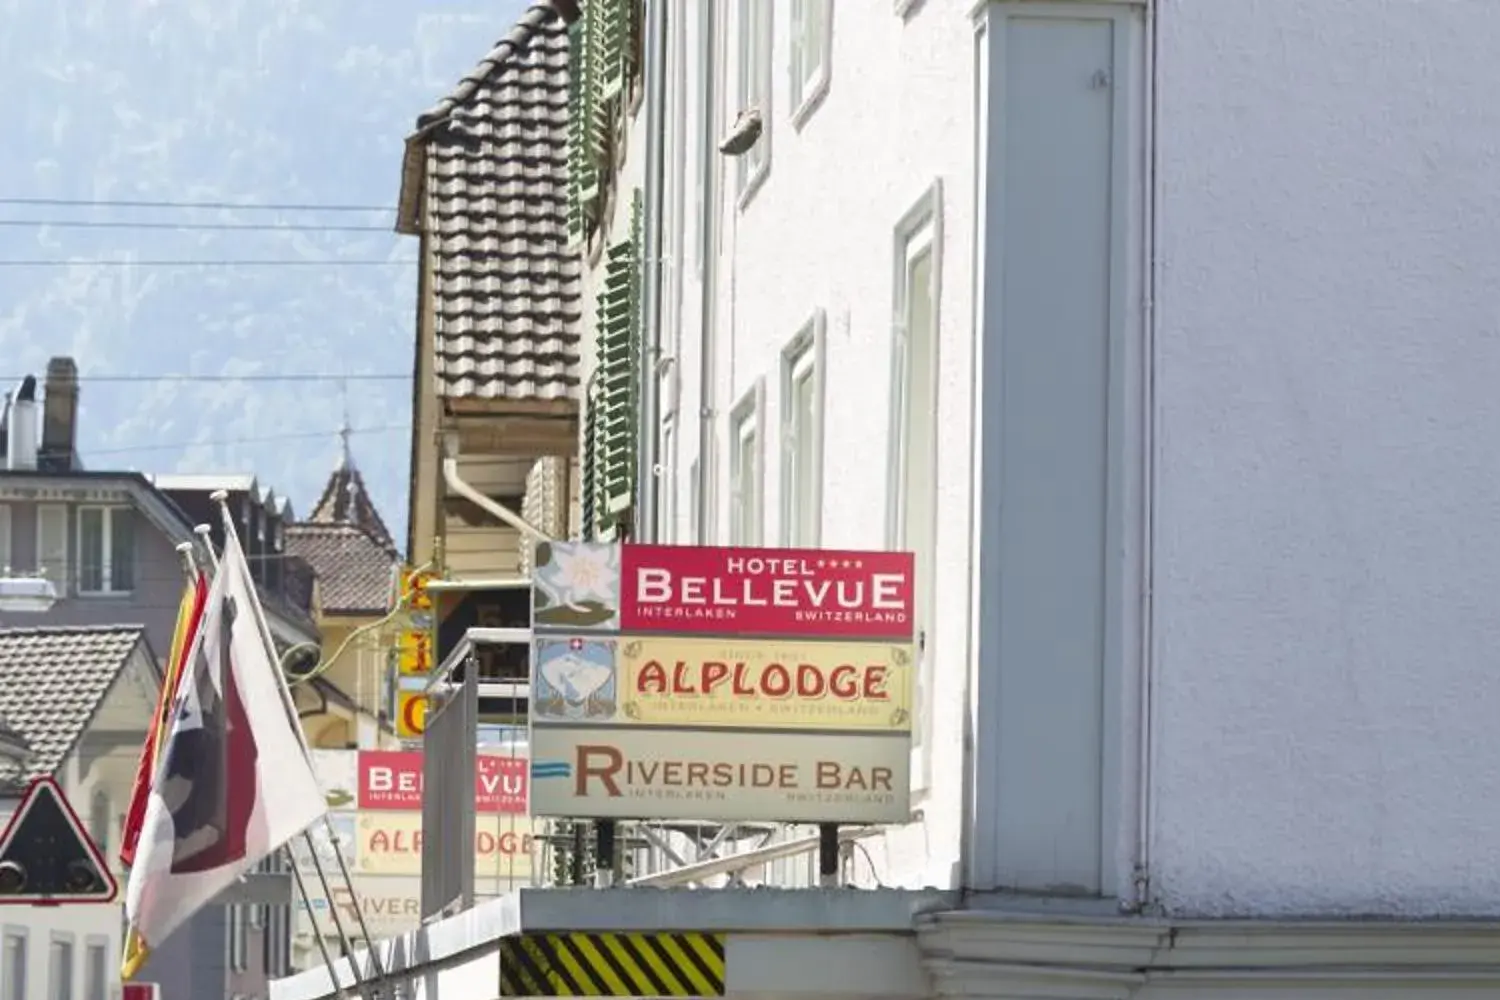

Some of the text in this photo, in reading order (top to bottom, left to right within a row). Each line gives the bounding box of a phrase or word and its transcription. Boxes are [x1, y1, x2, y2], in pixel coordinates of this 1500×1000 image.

[727, 557, 815, 575] HOTEL
[637, 567, 905, 609] BELLEVUE
[637, 607, 906, 623] INTERLAKEN SWITZERLAND
[637, 659, 889, 699] ALPLODGE
[574, 745, 894, 797] RIVERSIDE BAR
[628, 789, 895, 804] INTERLAKEN SWITZERLAND
